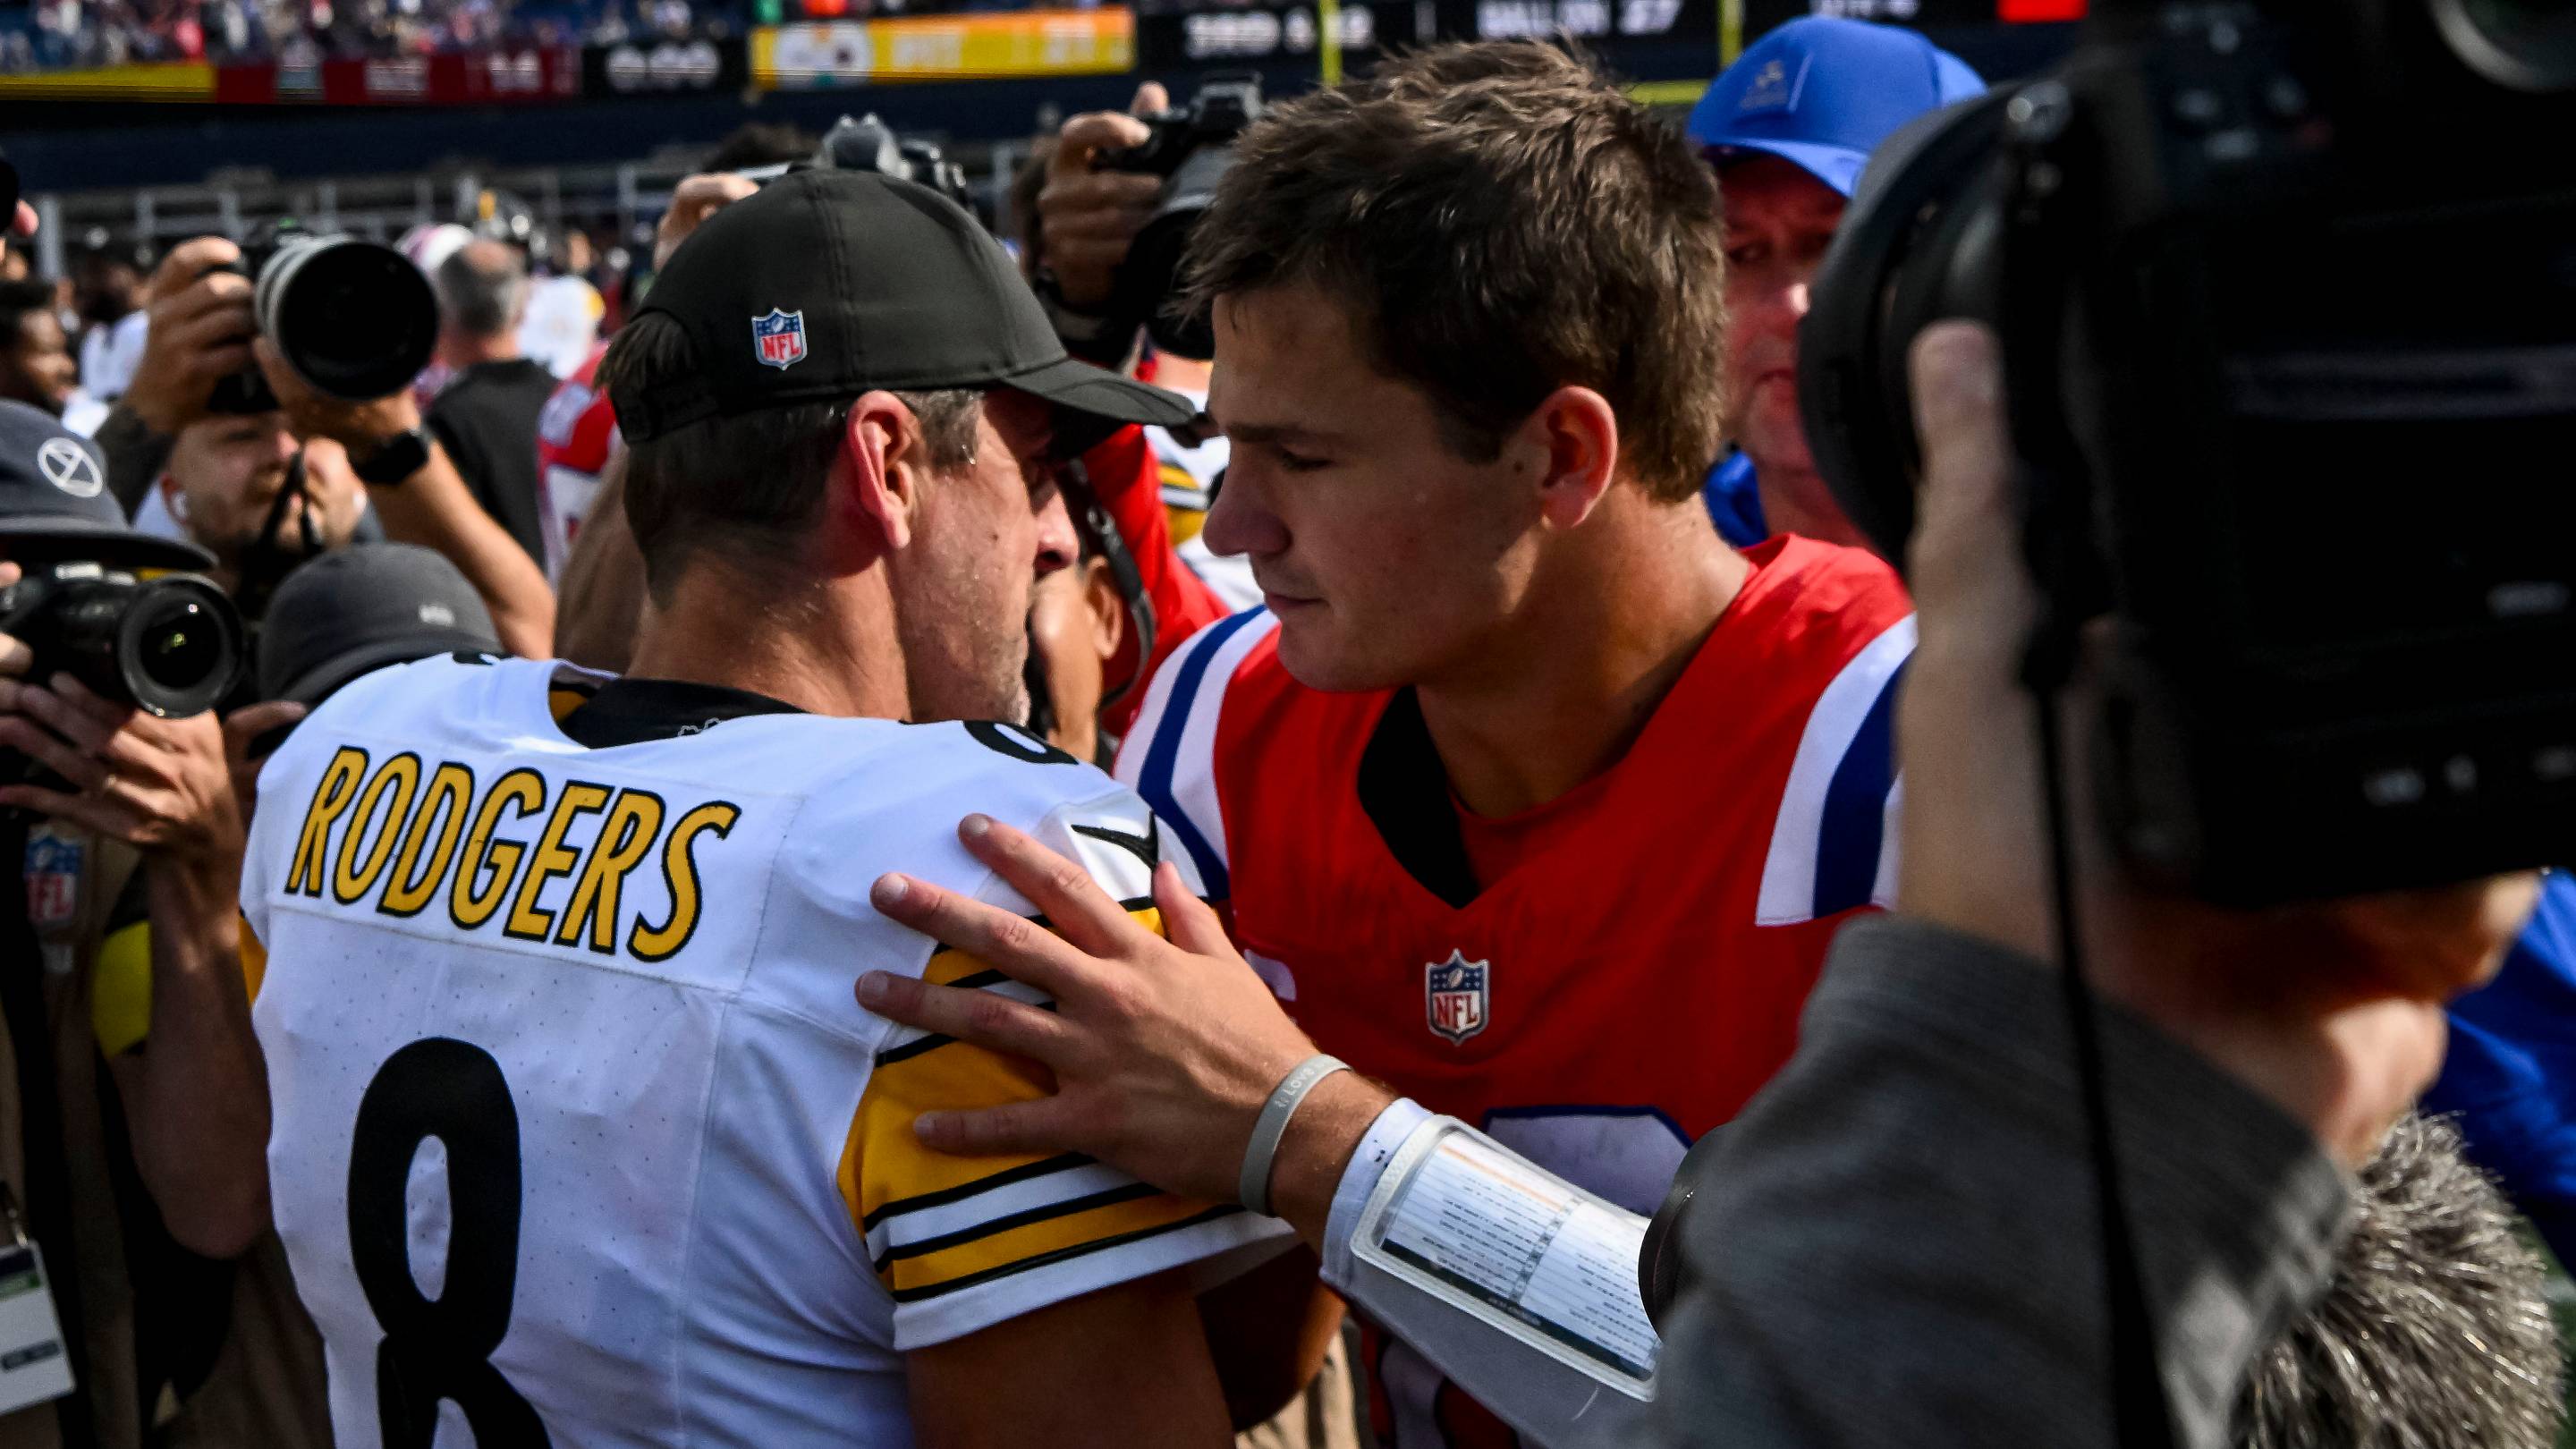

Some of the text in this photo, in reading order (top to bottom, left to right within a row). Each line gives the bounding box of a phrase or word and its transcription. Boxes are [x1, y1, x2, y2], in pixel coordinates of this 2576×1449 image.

[761, 332, 802, 360] NFL
[284, 745, 742, 963] RODGERS
[1433, 992, 1480, 1030] NFL
